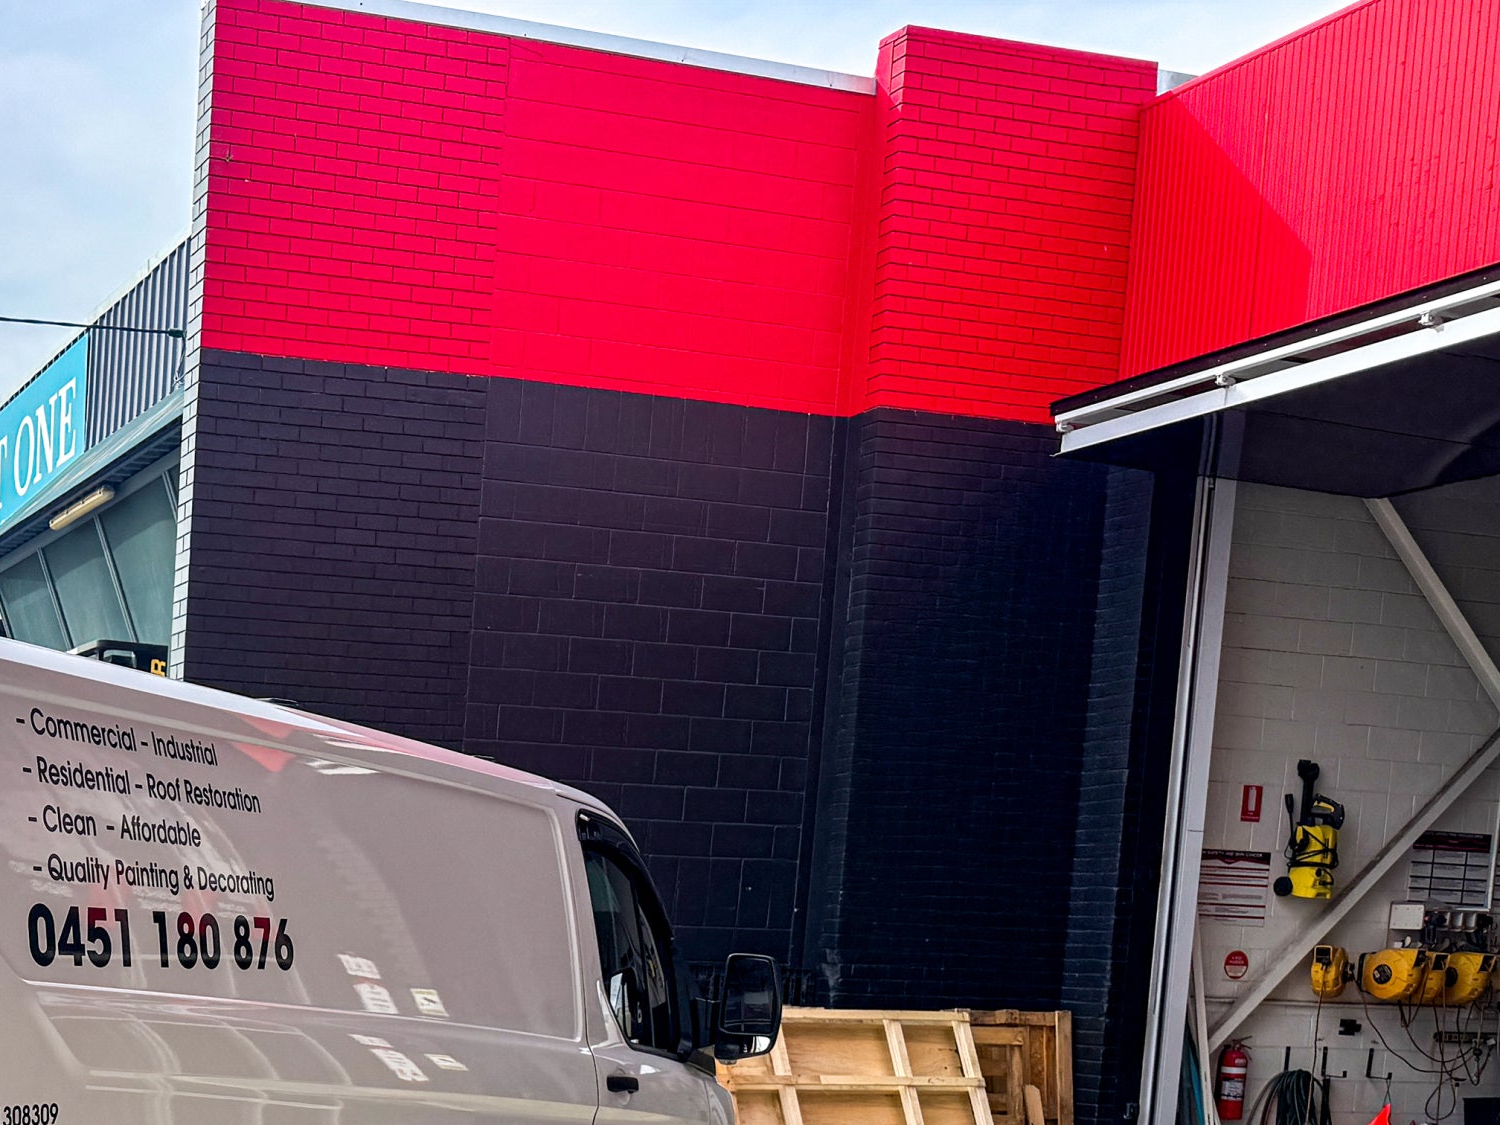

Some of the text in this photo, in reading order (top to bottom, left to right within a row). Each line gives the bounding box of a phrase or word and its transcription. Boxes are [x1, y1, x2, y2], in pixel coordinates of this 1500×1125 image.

[13, 376, 77, 497] ONE
[30, 707, 137, 752] Commercial
[151, 731, 218, 766] Industrial
[37, 756, 131, 794] Residential
[146, 774, 182, 802] Roof
[184, 780, 261, 813] Restoration
[43, 804, 97, 836] Clean
[120, 814, 201, 847] Affordable
[47, 853, 110, 890] Quality
[115, 859, 179, 895] Painting
[183, 865, 194, 890] &
[197, 867, 275, 902] Decorating
[28, 903, 294, 971] 0451 180 876
